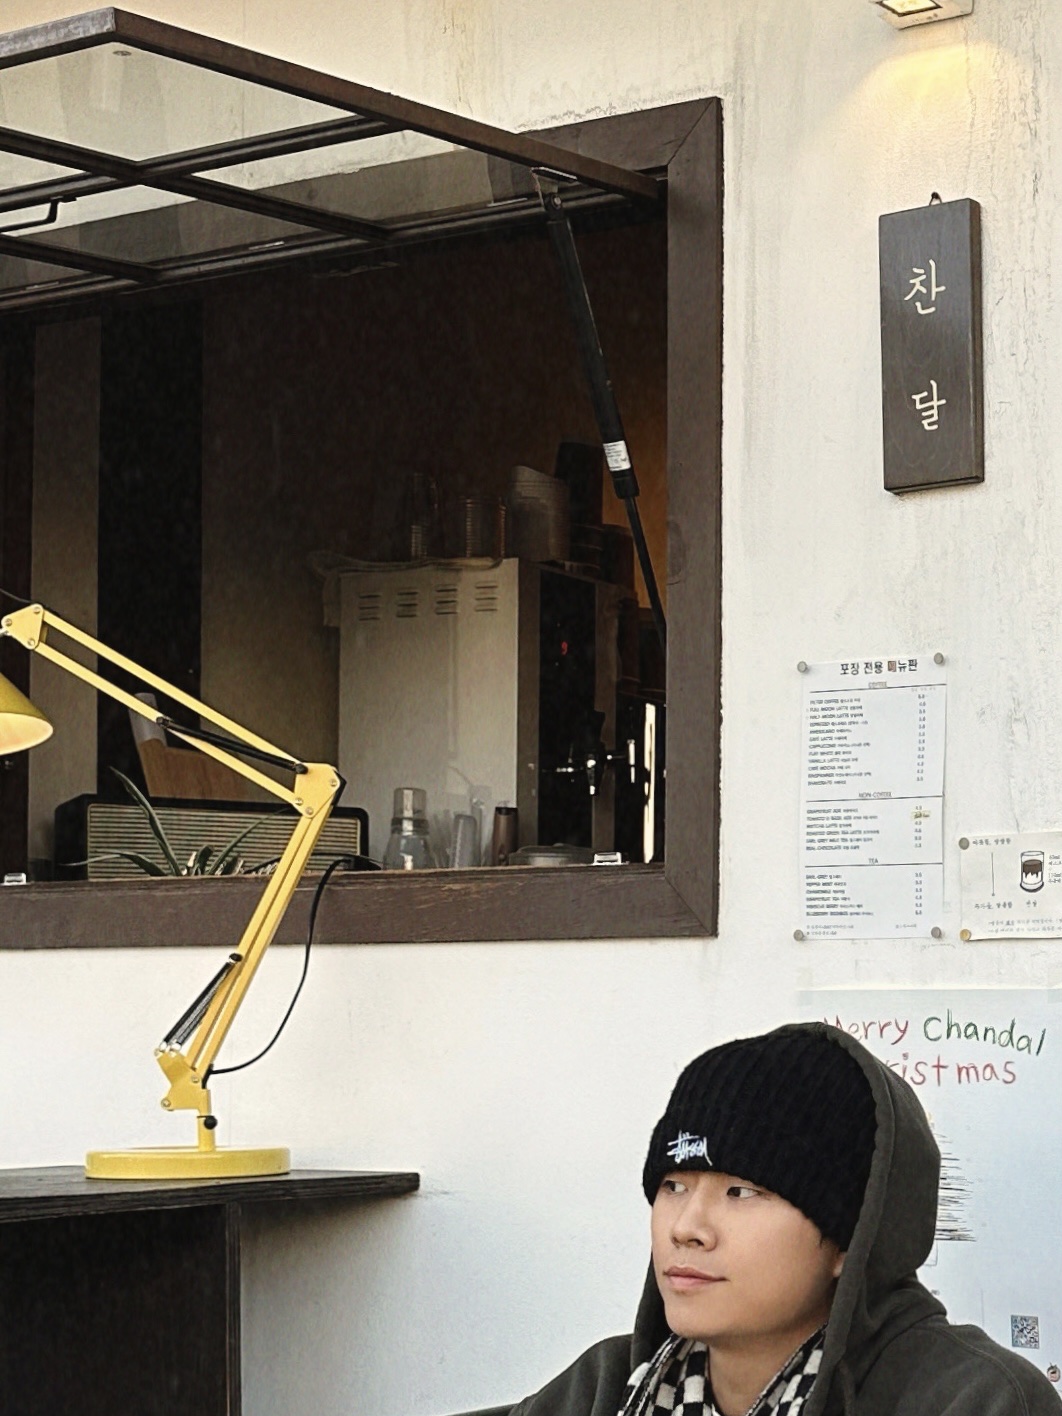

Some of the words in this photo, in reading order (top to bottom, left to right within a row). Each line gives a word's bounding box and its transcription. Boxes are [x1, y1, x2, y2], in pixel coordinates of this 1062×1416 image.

[904, 259, 946, 431] 찬달
[840, 662, 860, 675] 포장
[863, 661, 883, 674] 전용
[923, 1008, 1046, 1056] Chandal
